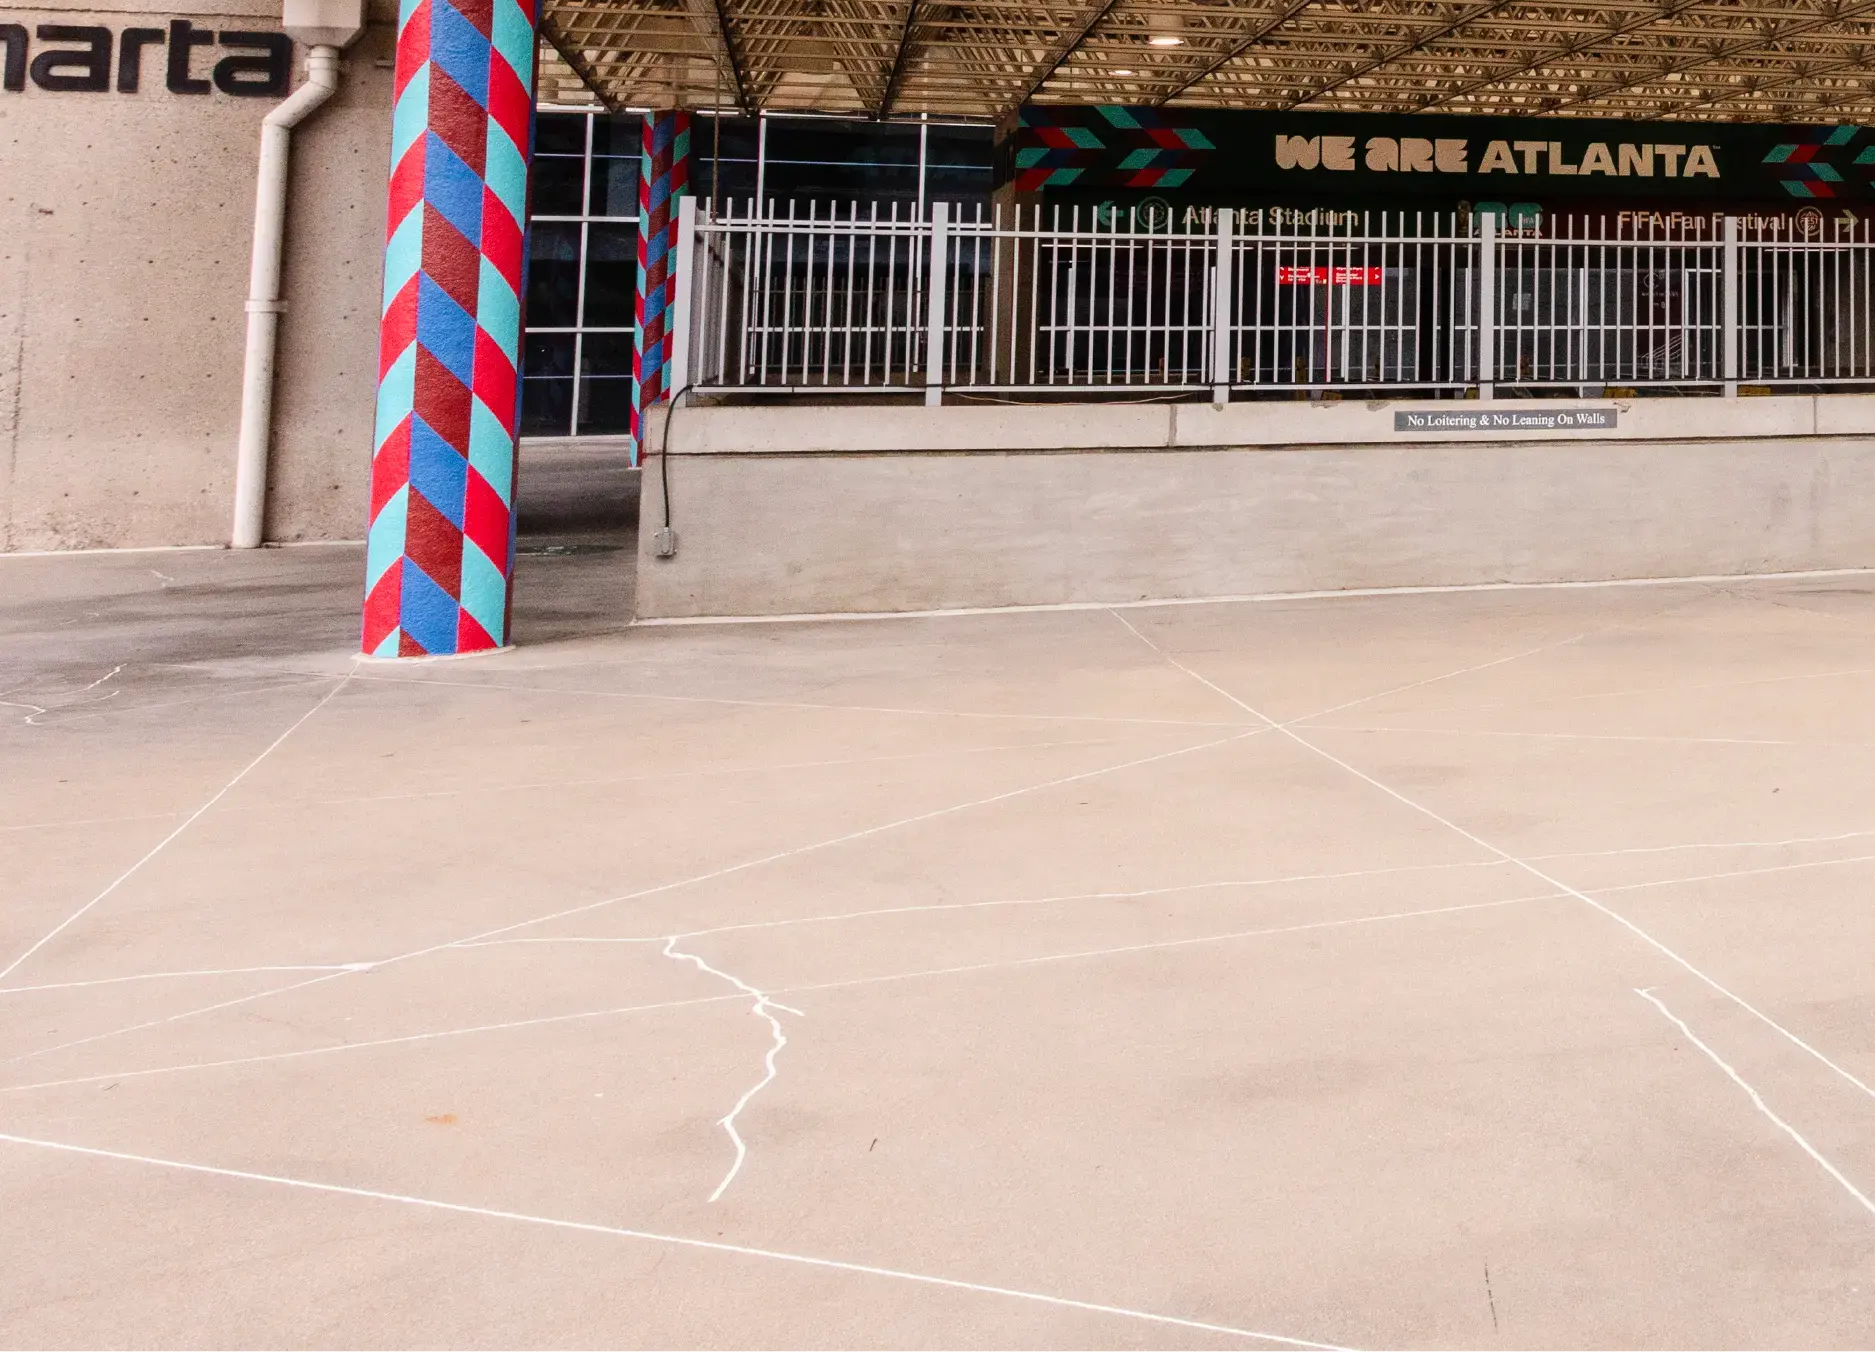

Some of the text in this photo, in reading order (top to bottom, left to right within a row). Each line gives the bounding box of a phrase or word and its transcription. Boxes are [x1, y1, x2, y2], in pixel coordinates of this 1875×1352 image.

[0, 19, 293, 98] arta
[1275, 134, 1355, 170] WE
[1365, 137, 1468, 172] ARE
[1478, 140, 1721, 178] ATLANTA
[1268, 205, 1359, 227] Stadium
[1618, 210, 1786, 230] FIFA Fan Fstival
[1408, 412, 1606, 428] No Loitering & No Leaning On Walls
